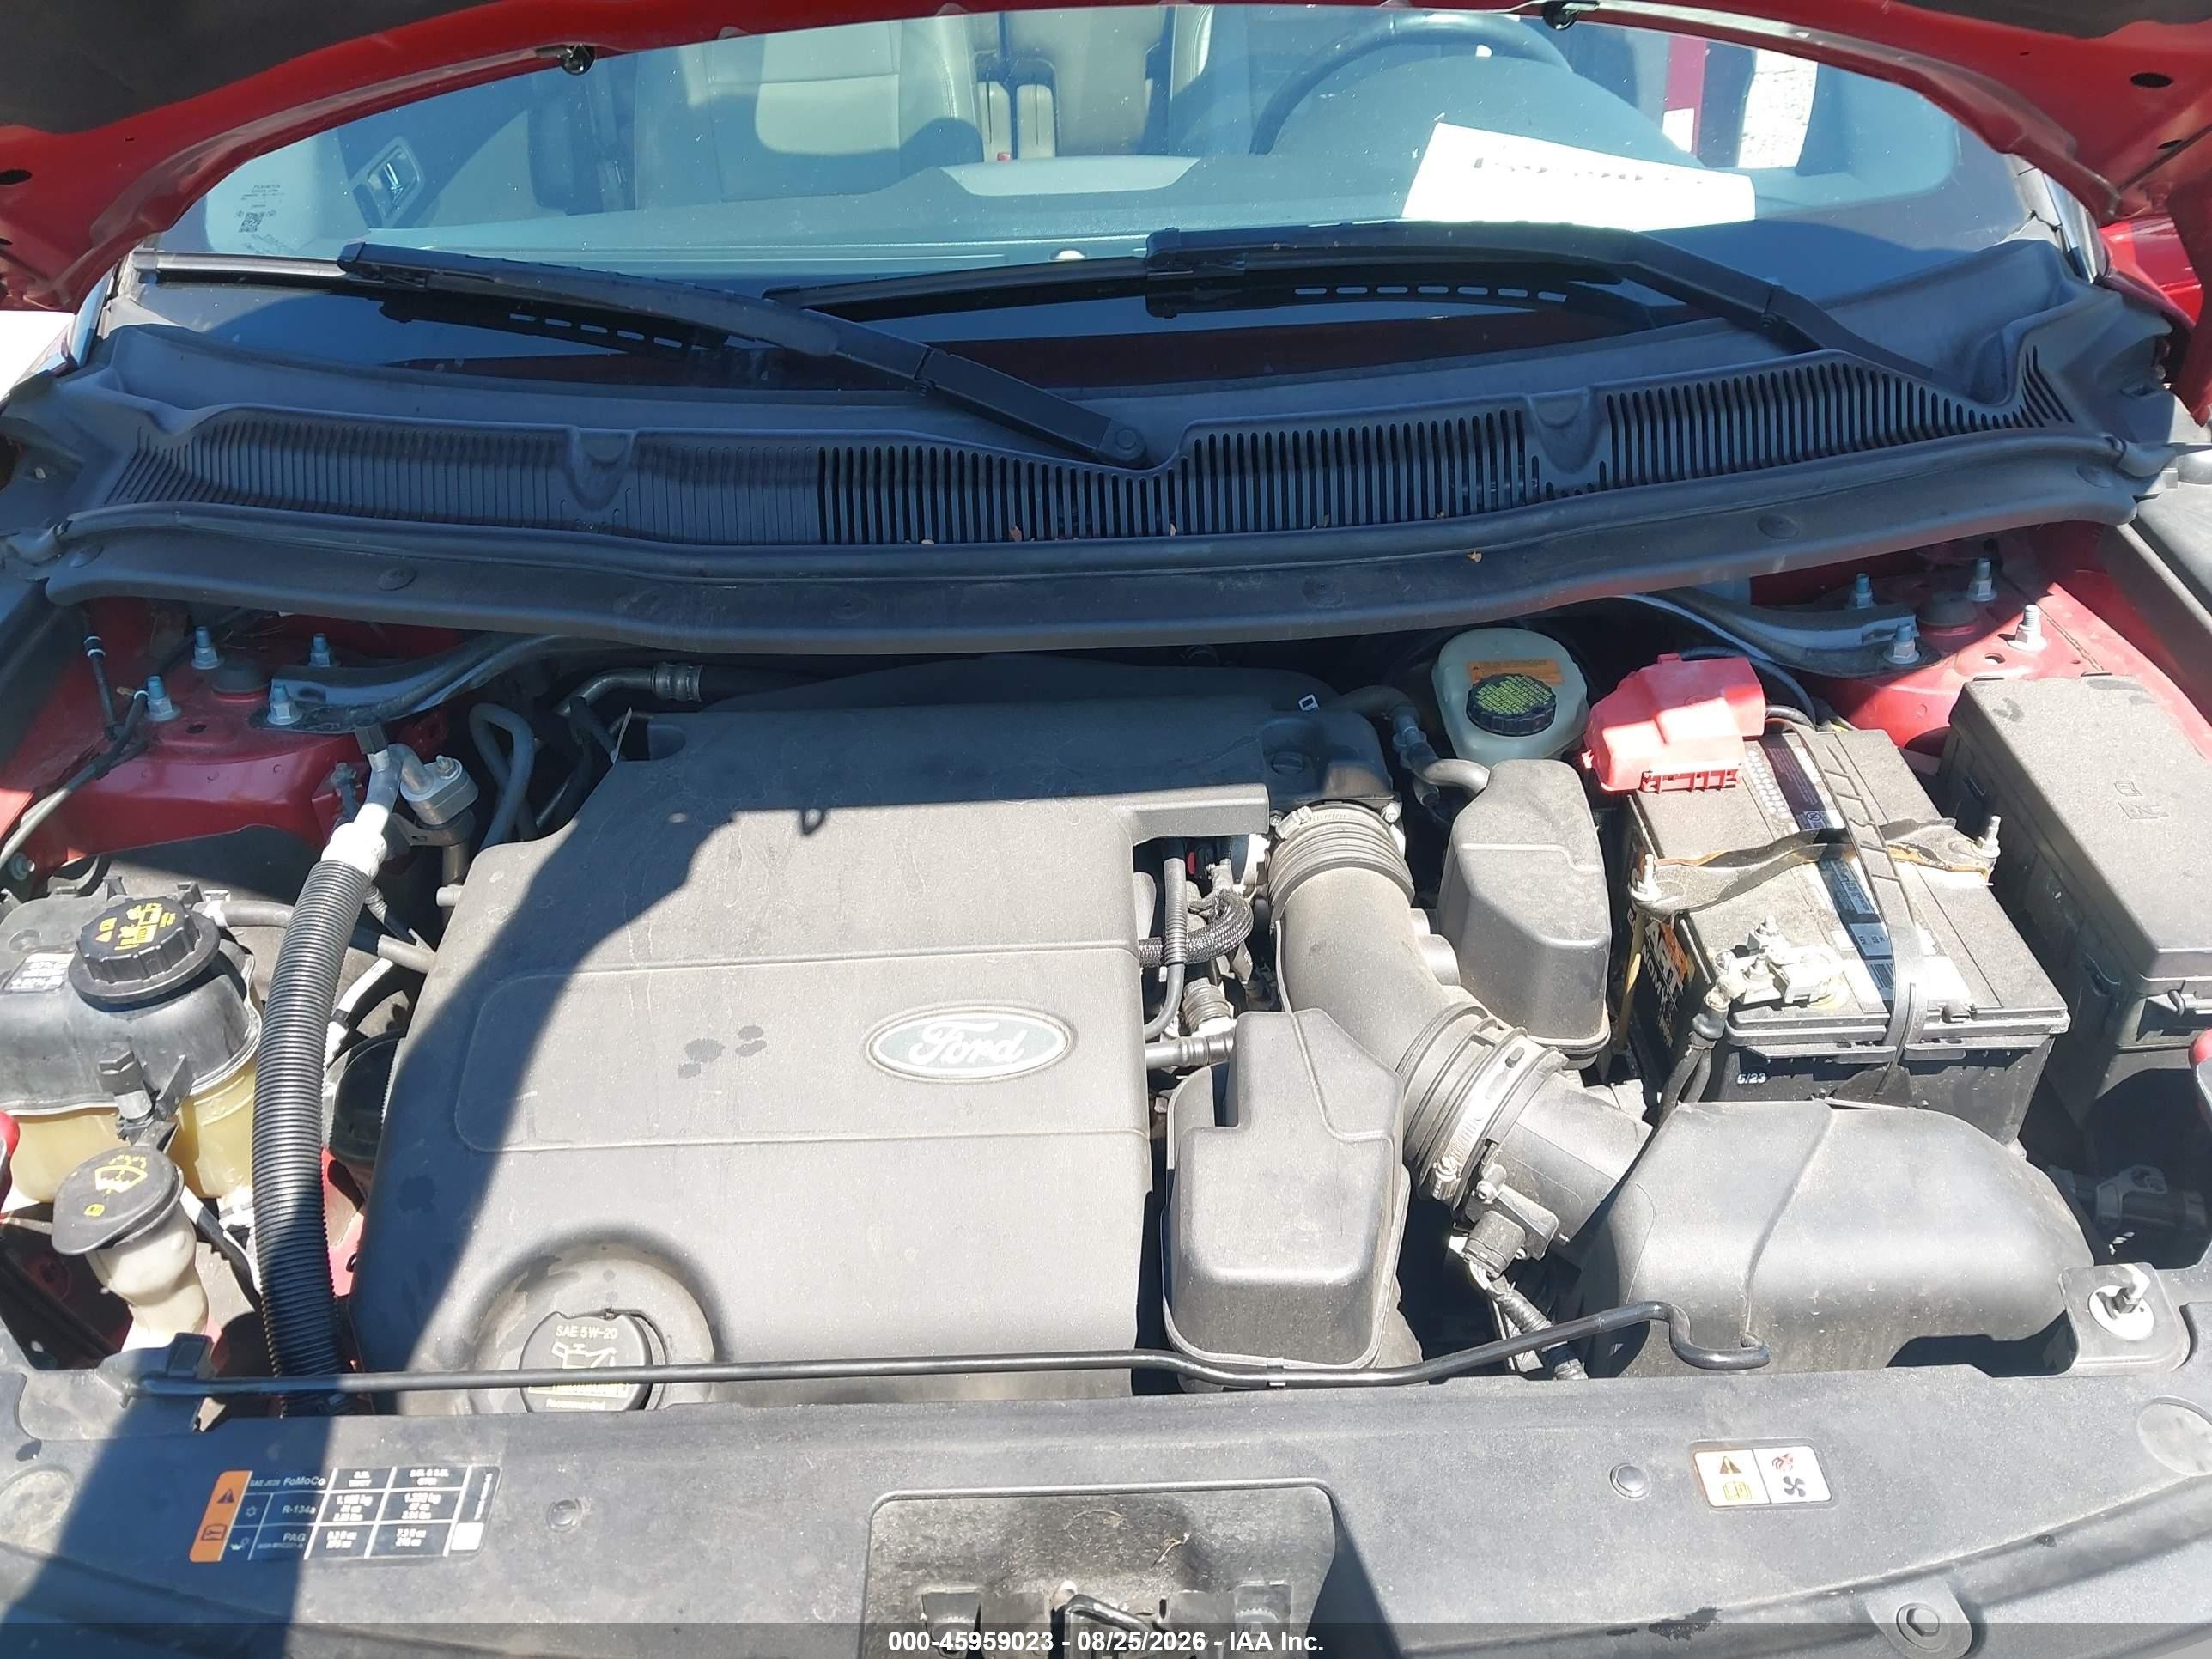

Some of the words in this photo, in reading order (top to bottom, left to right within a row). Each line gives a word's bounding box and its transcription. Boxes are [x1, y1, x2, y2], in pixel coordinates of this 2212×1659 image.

[908, 1021, 1028, 1065] Ford
[1737, 1073, 1766, 1085] 5/23
[556, 1325, 578, 1338] SAE
[580, 1327, 617, 1340] 5W-20
[283, 1476, 326, 1486] FoMoCo
[282, 1504, 316, 1514] R-134a
[283, 1532, 307, 1542] PAG
